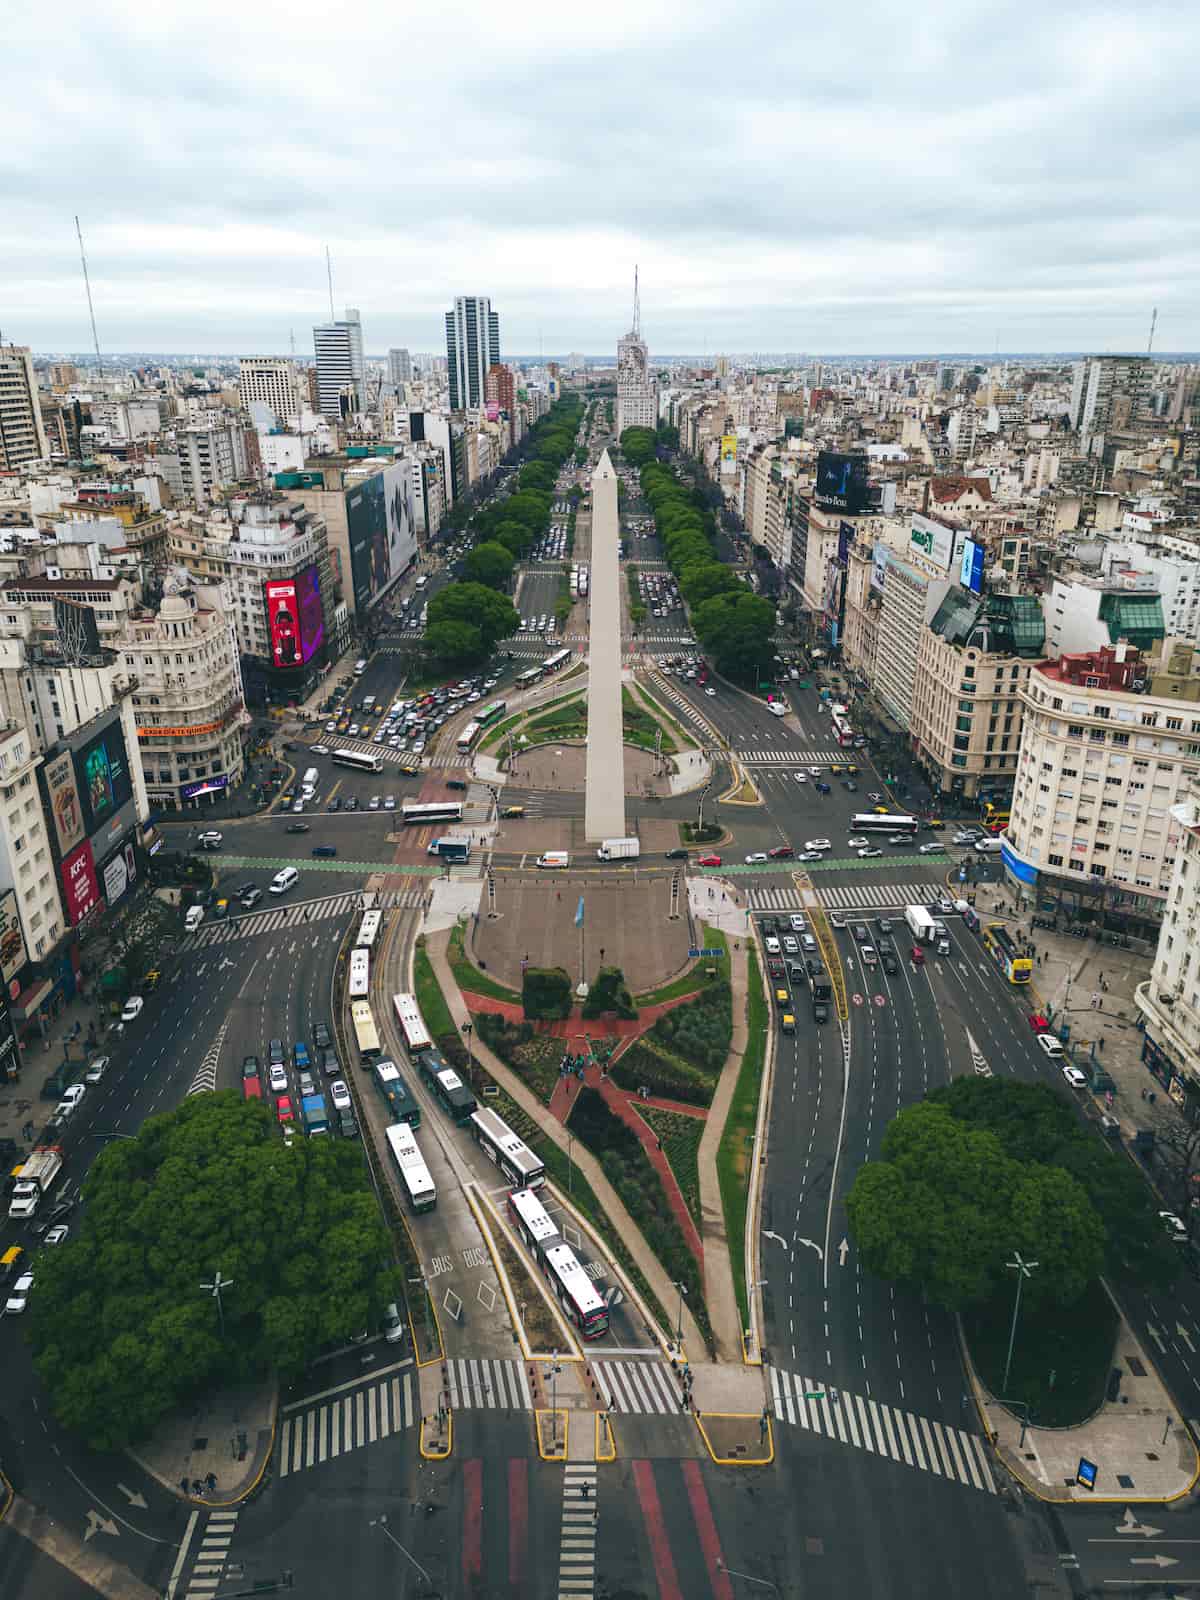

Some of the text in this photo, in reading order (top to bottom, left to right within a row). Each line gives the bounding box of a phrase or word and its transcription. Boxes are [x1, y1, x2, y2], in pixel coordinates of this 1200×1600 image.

[70, 853, 87, 878] KFC
[431, 1256, 453, 1272] BUS
[463, 1248, 485, 1268] BUS
